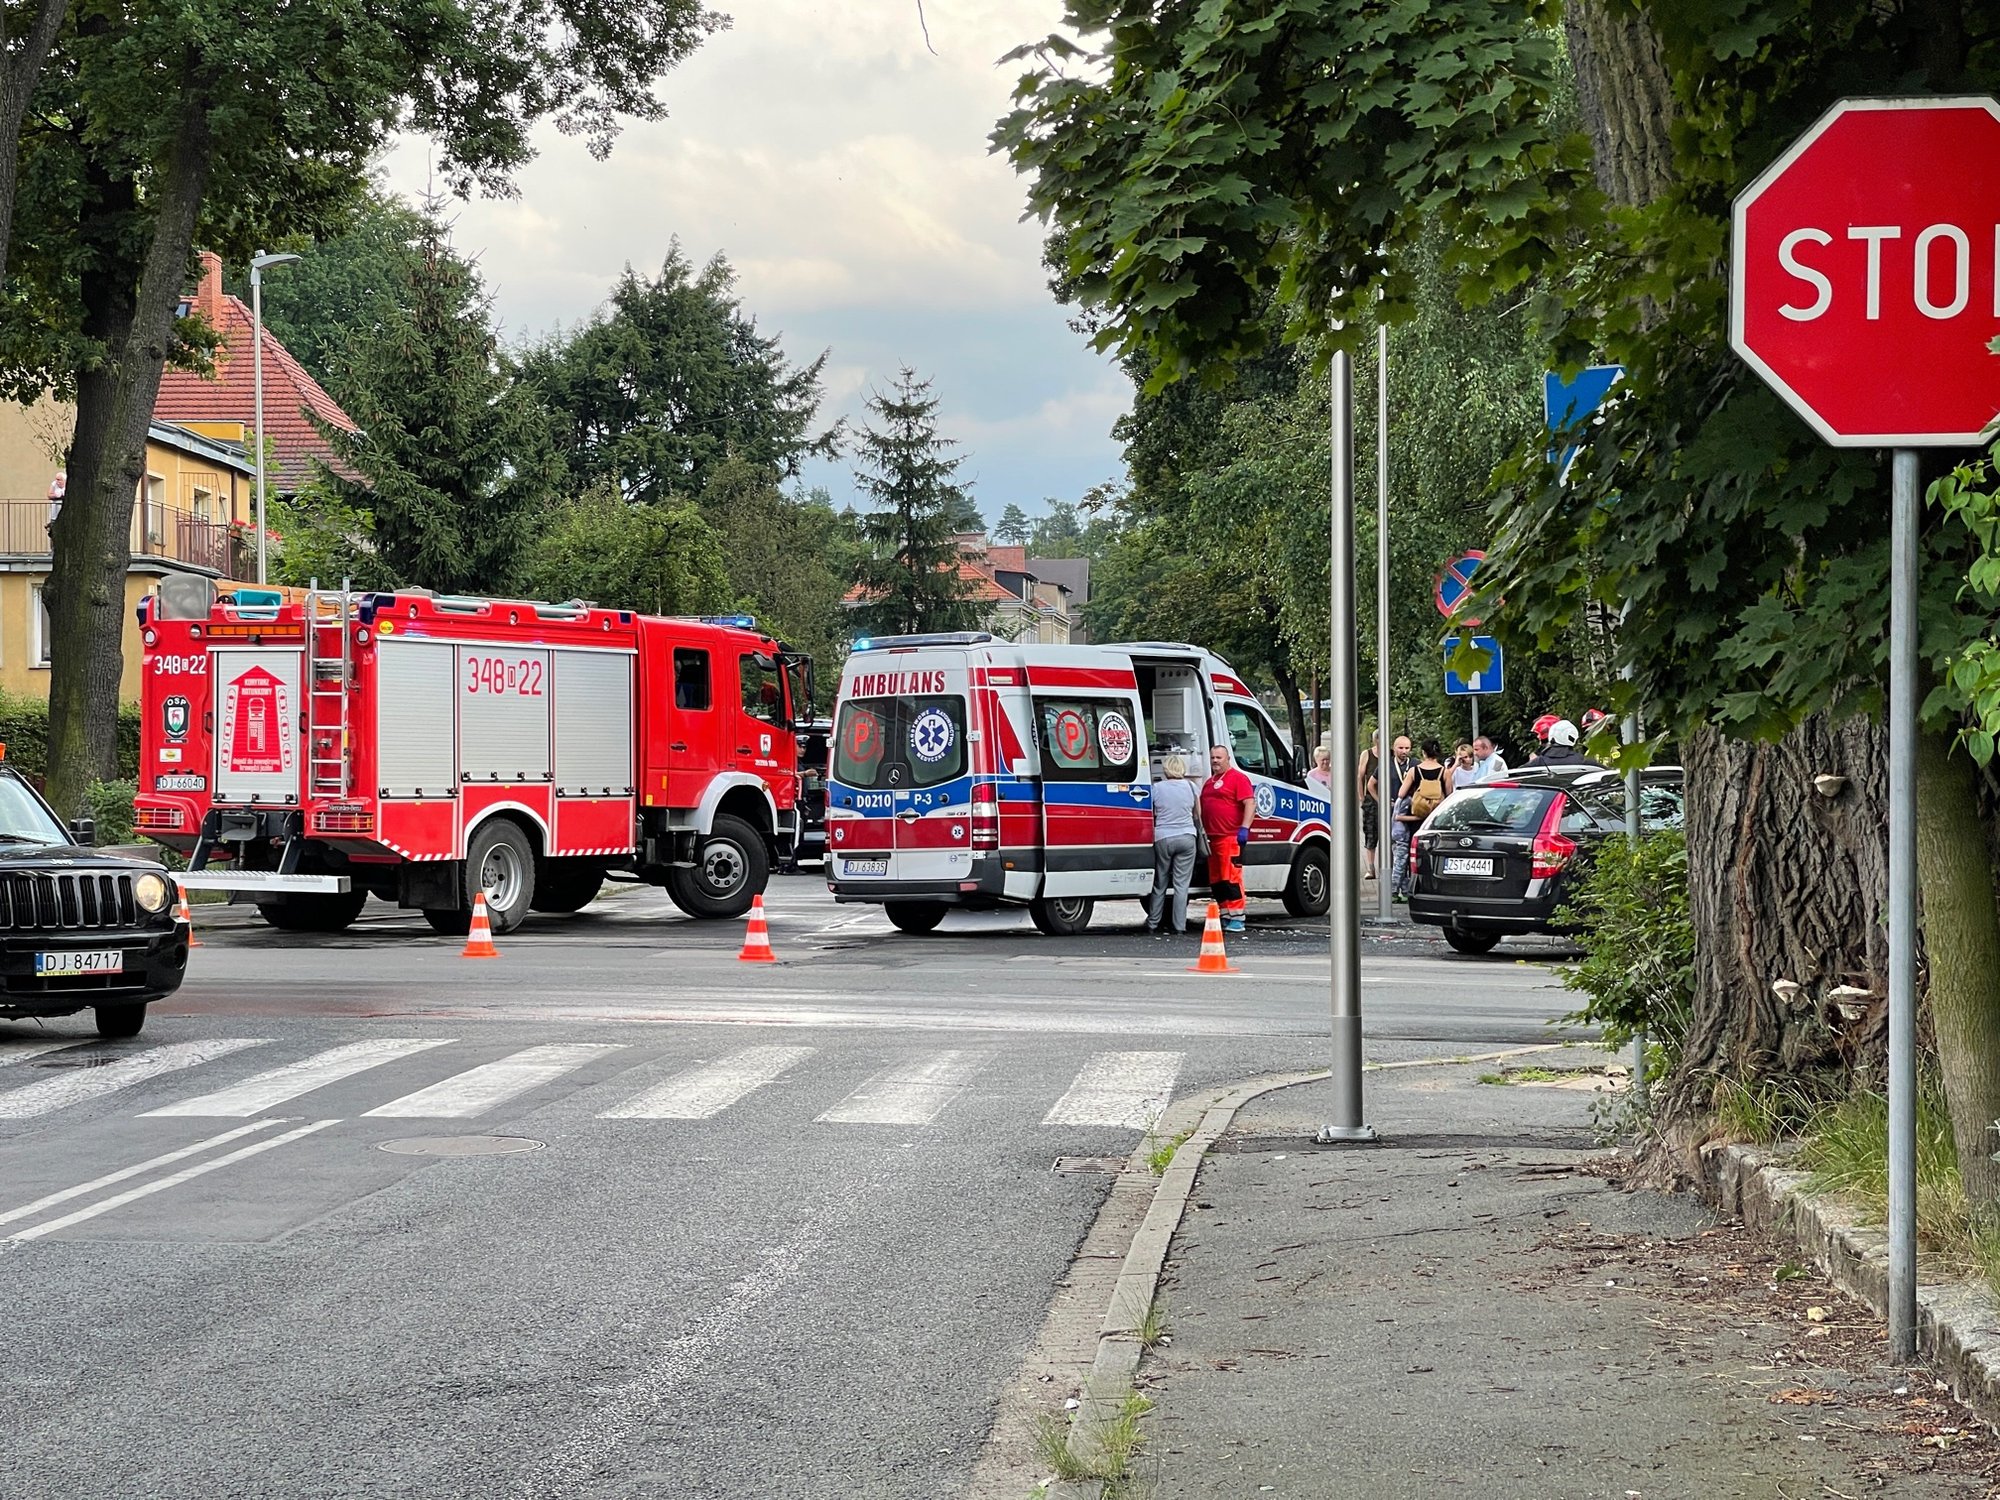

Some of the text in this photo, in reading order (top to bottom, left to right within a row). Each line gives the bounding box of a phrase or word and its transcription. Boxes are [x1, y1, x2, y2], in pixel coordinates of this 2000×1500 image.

[1777, 222, 2000, 322] STO
[851, 670, 946, 698] AMBULANS
[167, 697, 187, 706] OSP
[854, 723, 870, 753] P
[1064, 721, 1079, 752] P
[856, 793, 932, 808] D0210 P-3
[1281, 798, 1325, 814] P-3 D0210
[1448, 859, 1491, 872] ZST 64441
[46, 954, 67, 970] DJ
[74, 952, 120, 970] 84717
